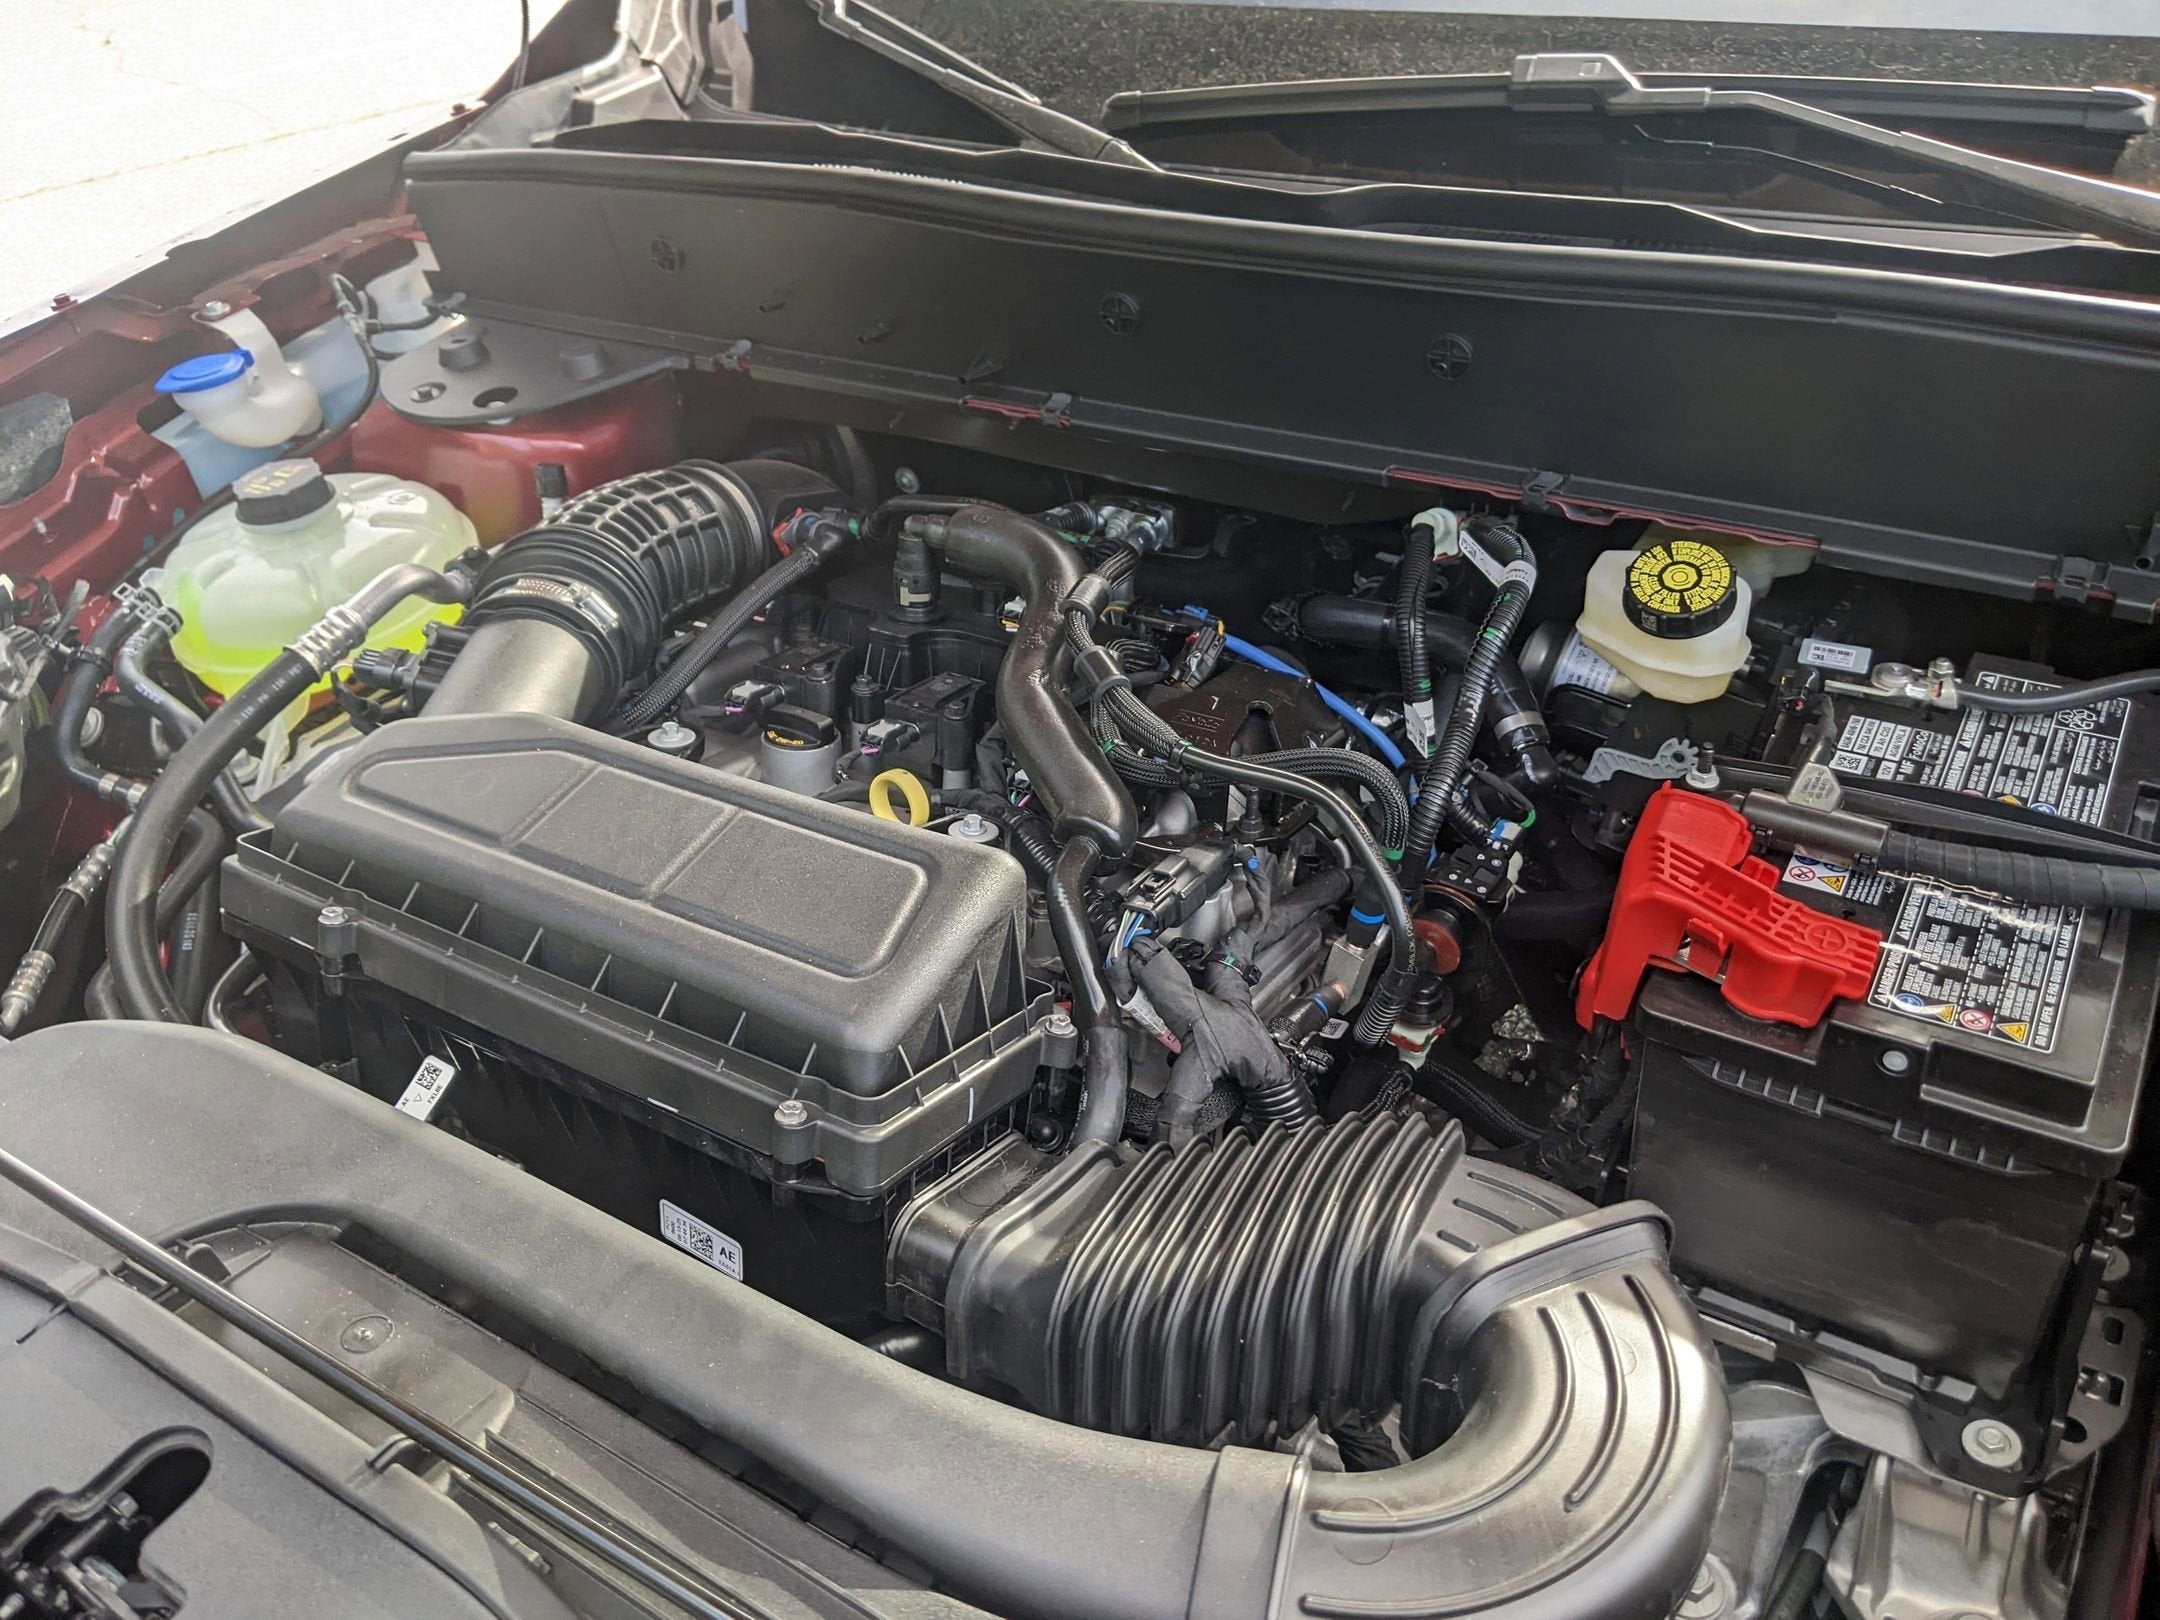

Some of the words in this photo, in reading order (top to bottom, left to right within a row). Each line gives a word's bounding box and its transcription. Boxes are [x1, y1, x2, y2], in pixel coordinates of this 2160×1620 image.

[1632, 586, 1650, 602] SEALED
[1647, 598, 1680, 613] CONTAINER
[1859, 734, 1870, 744] CCA
[1879, 726, 1891, 737] C20
[1876, 737, 1886, 746] Ah
[1888, 728, 1907, 758] AGM/VRLA
[1906, 730, 1931, 759] FoMoCo
[1880, 764, 1892, 775] 12V
[1898, 759, 1915, 774] MF
[2073, 757, 2083, 773] CONTRA
[1877, 943, 1906, 996] DANGER/POISN
[1910, 969, 1926, 993] EXPLOSIVE
[2039, 1005, 2054, 1023] OPEN.
[2037, 1021, 2049, 1036] NOT
[719, 1247, 736, 1264] AE
